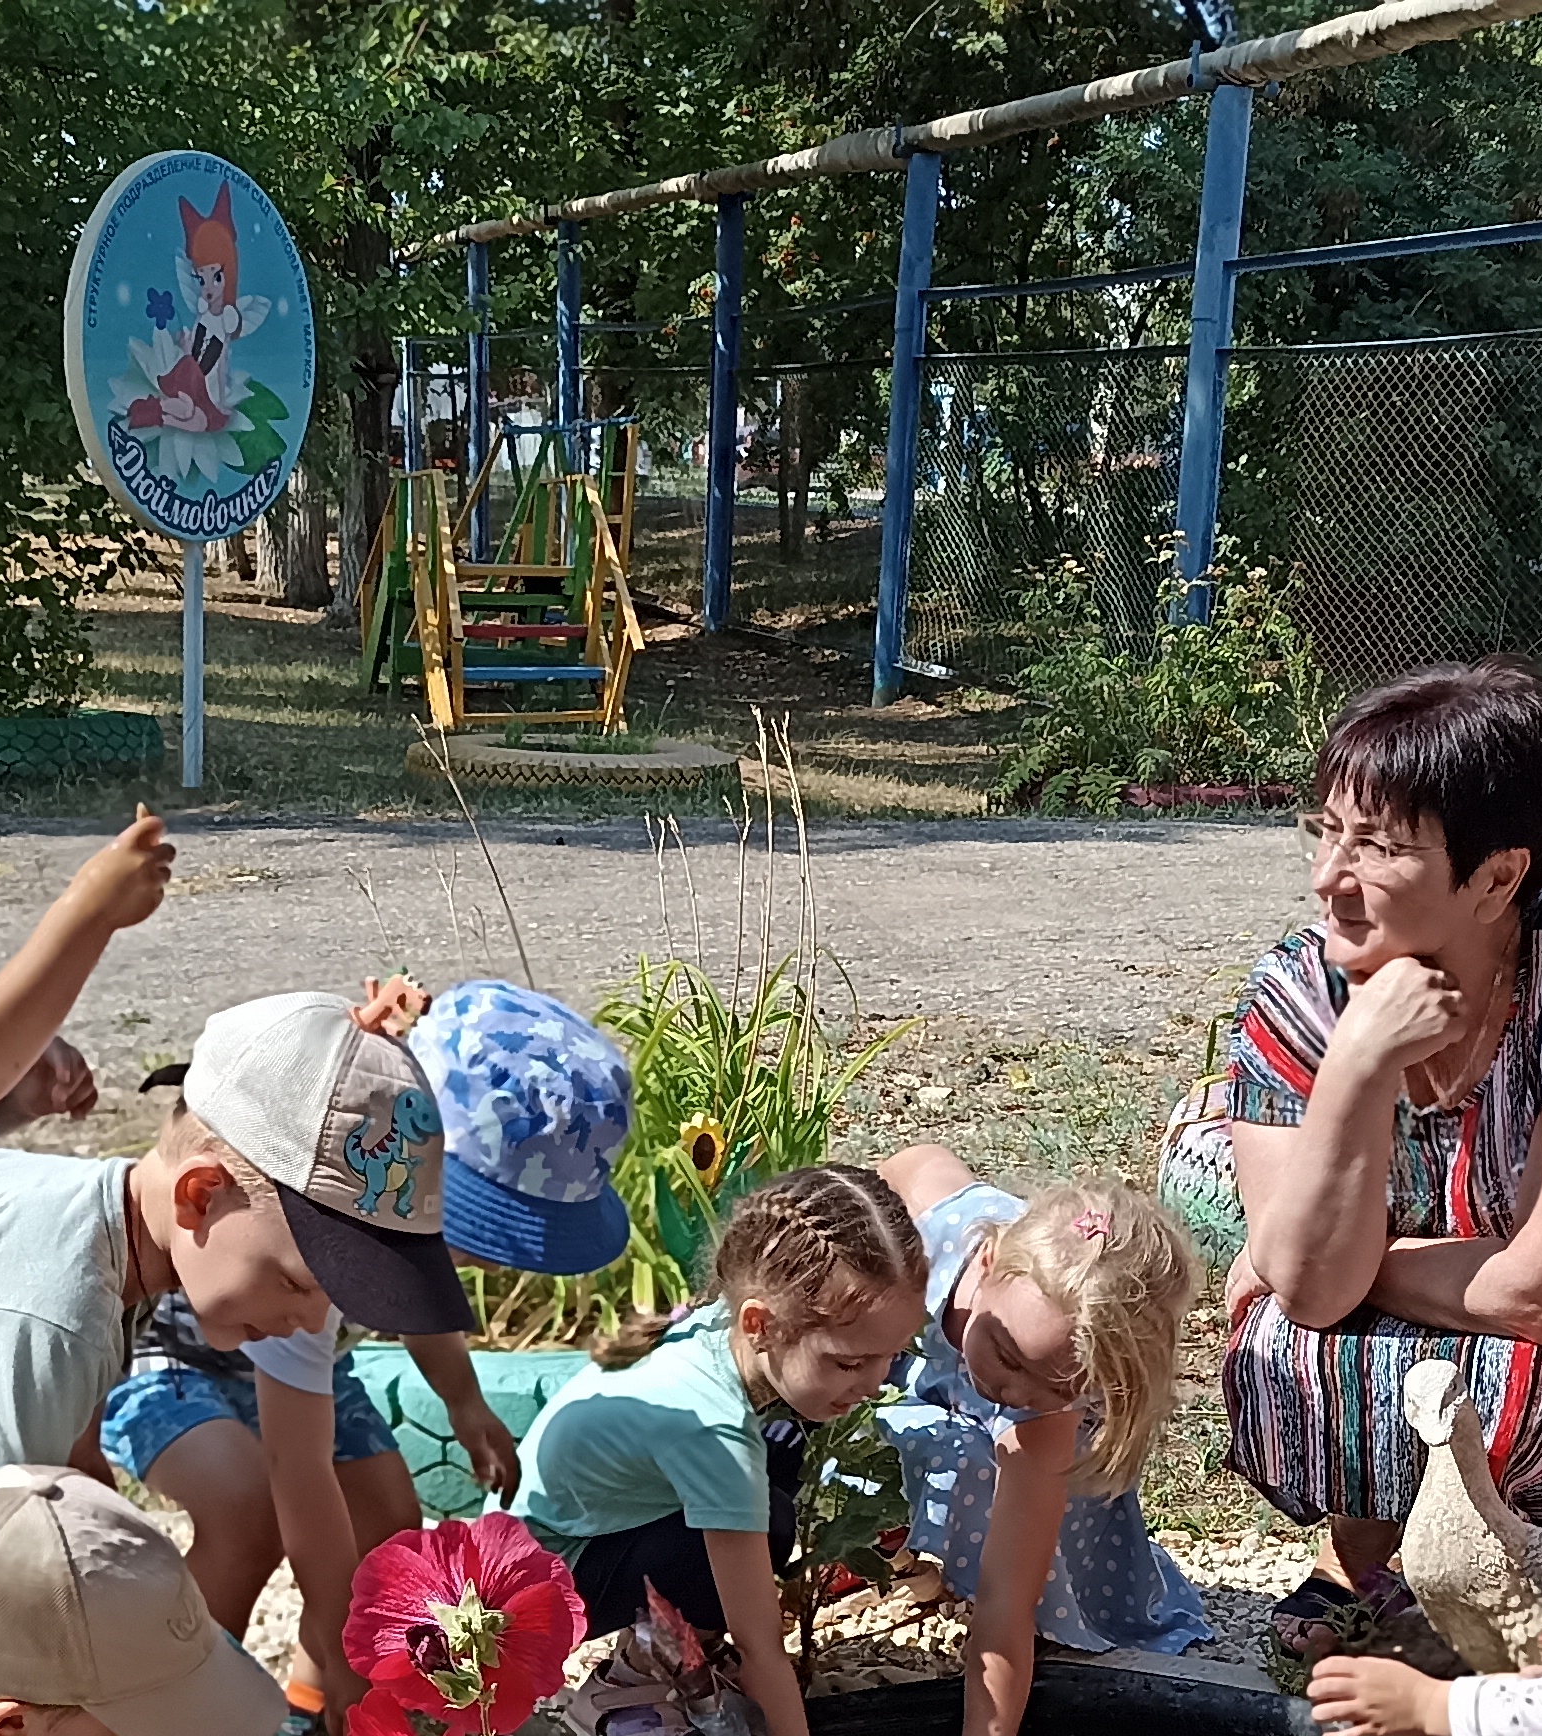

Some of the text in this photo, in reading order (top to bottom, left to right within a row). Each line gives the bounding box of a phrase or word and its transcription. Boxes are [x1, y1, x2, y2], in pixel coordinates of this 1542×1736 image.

[87, 214, 122, 329] СТРУКТУРНОЕ
[117, 157, 202, 217] ПОДРАЗДЕЛЕНИЕ
[251, 187, 271, 217] САД
